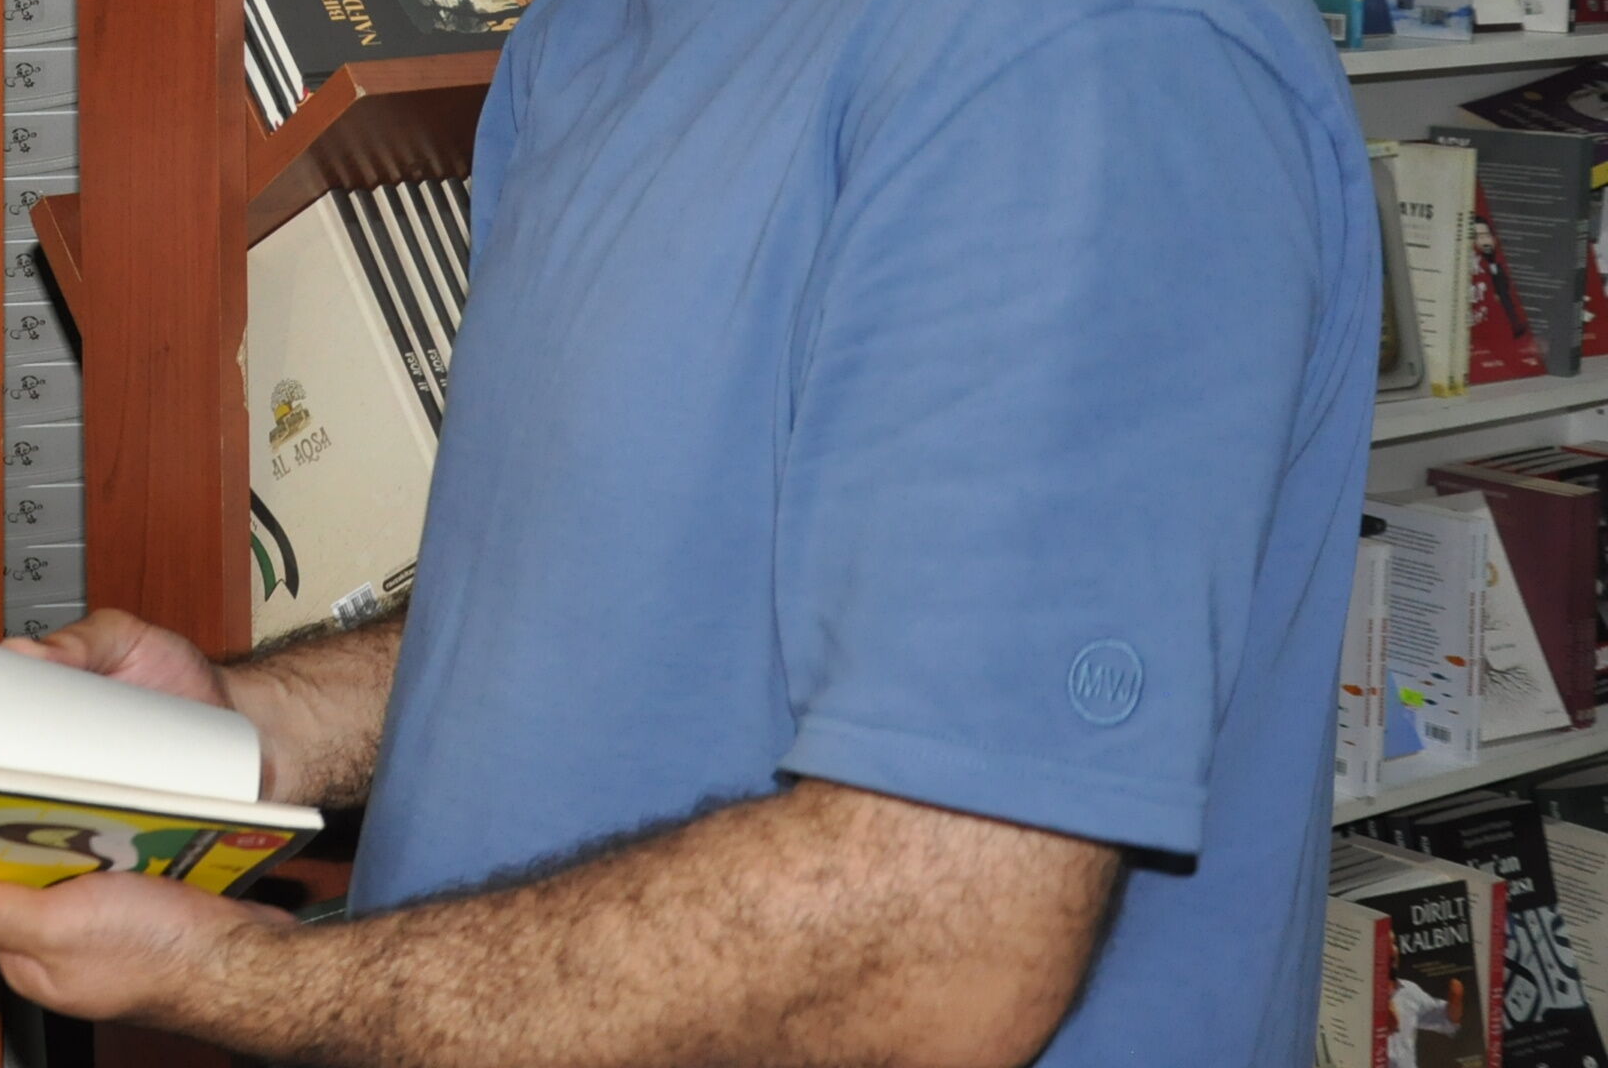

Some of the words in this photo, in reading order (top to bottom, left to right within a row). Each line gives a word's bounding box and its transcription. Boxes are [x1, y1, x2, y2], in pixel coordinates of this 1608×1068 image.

[294, 427, 332, 467] AQSA
[1411, 894, 1465, 926] DİRİLT
[1399, 918, 1470, 954] KALBİNİ
